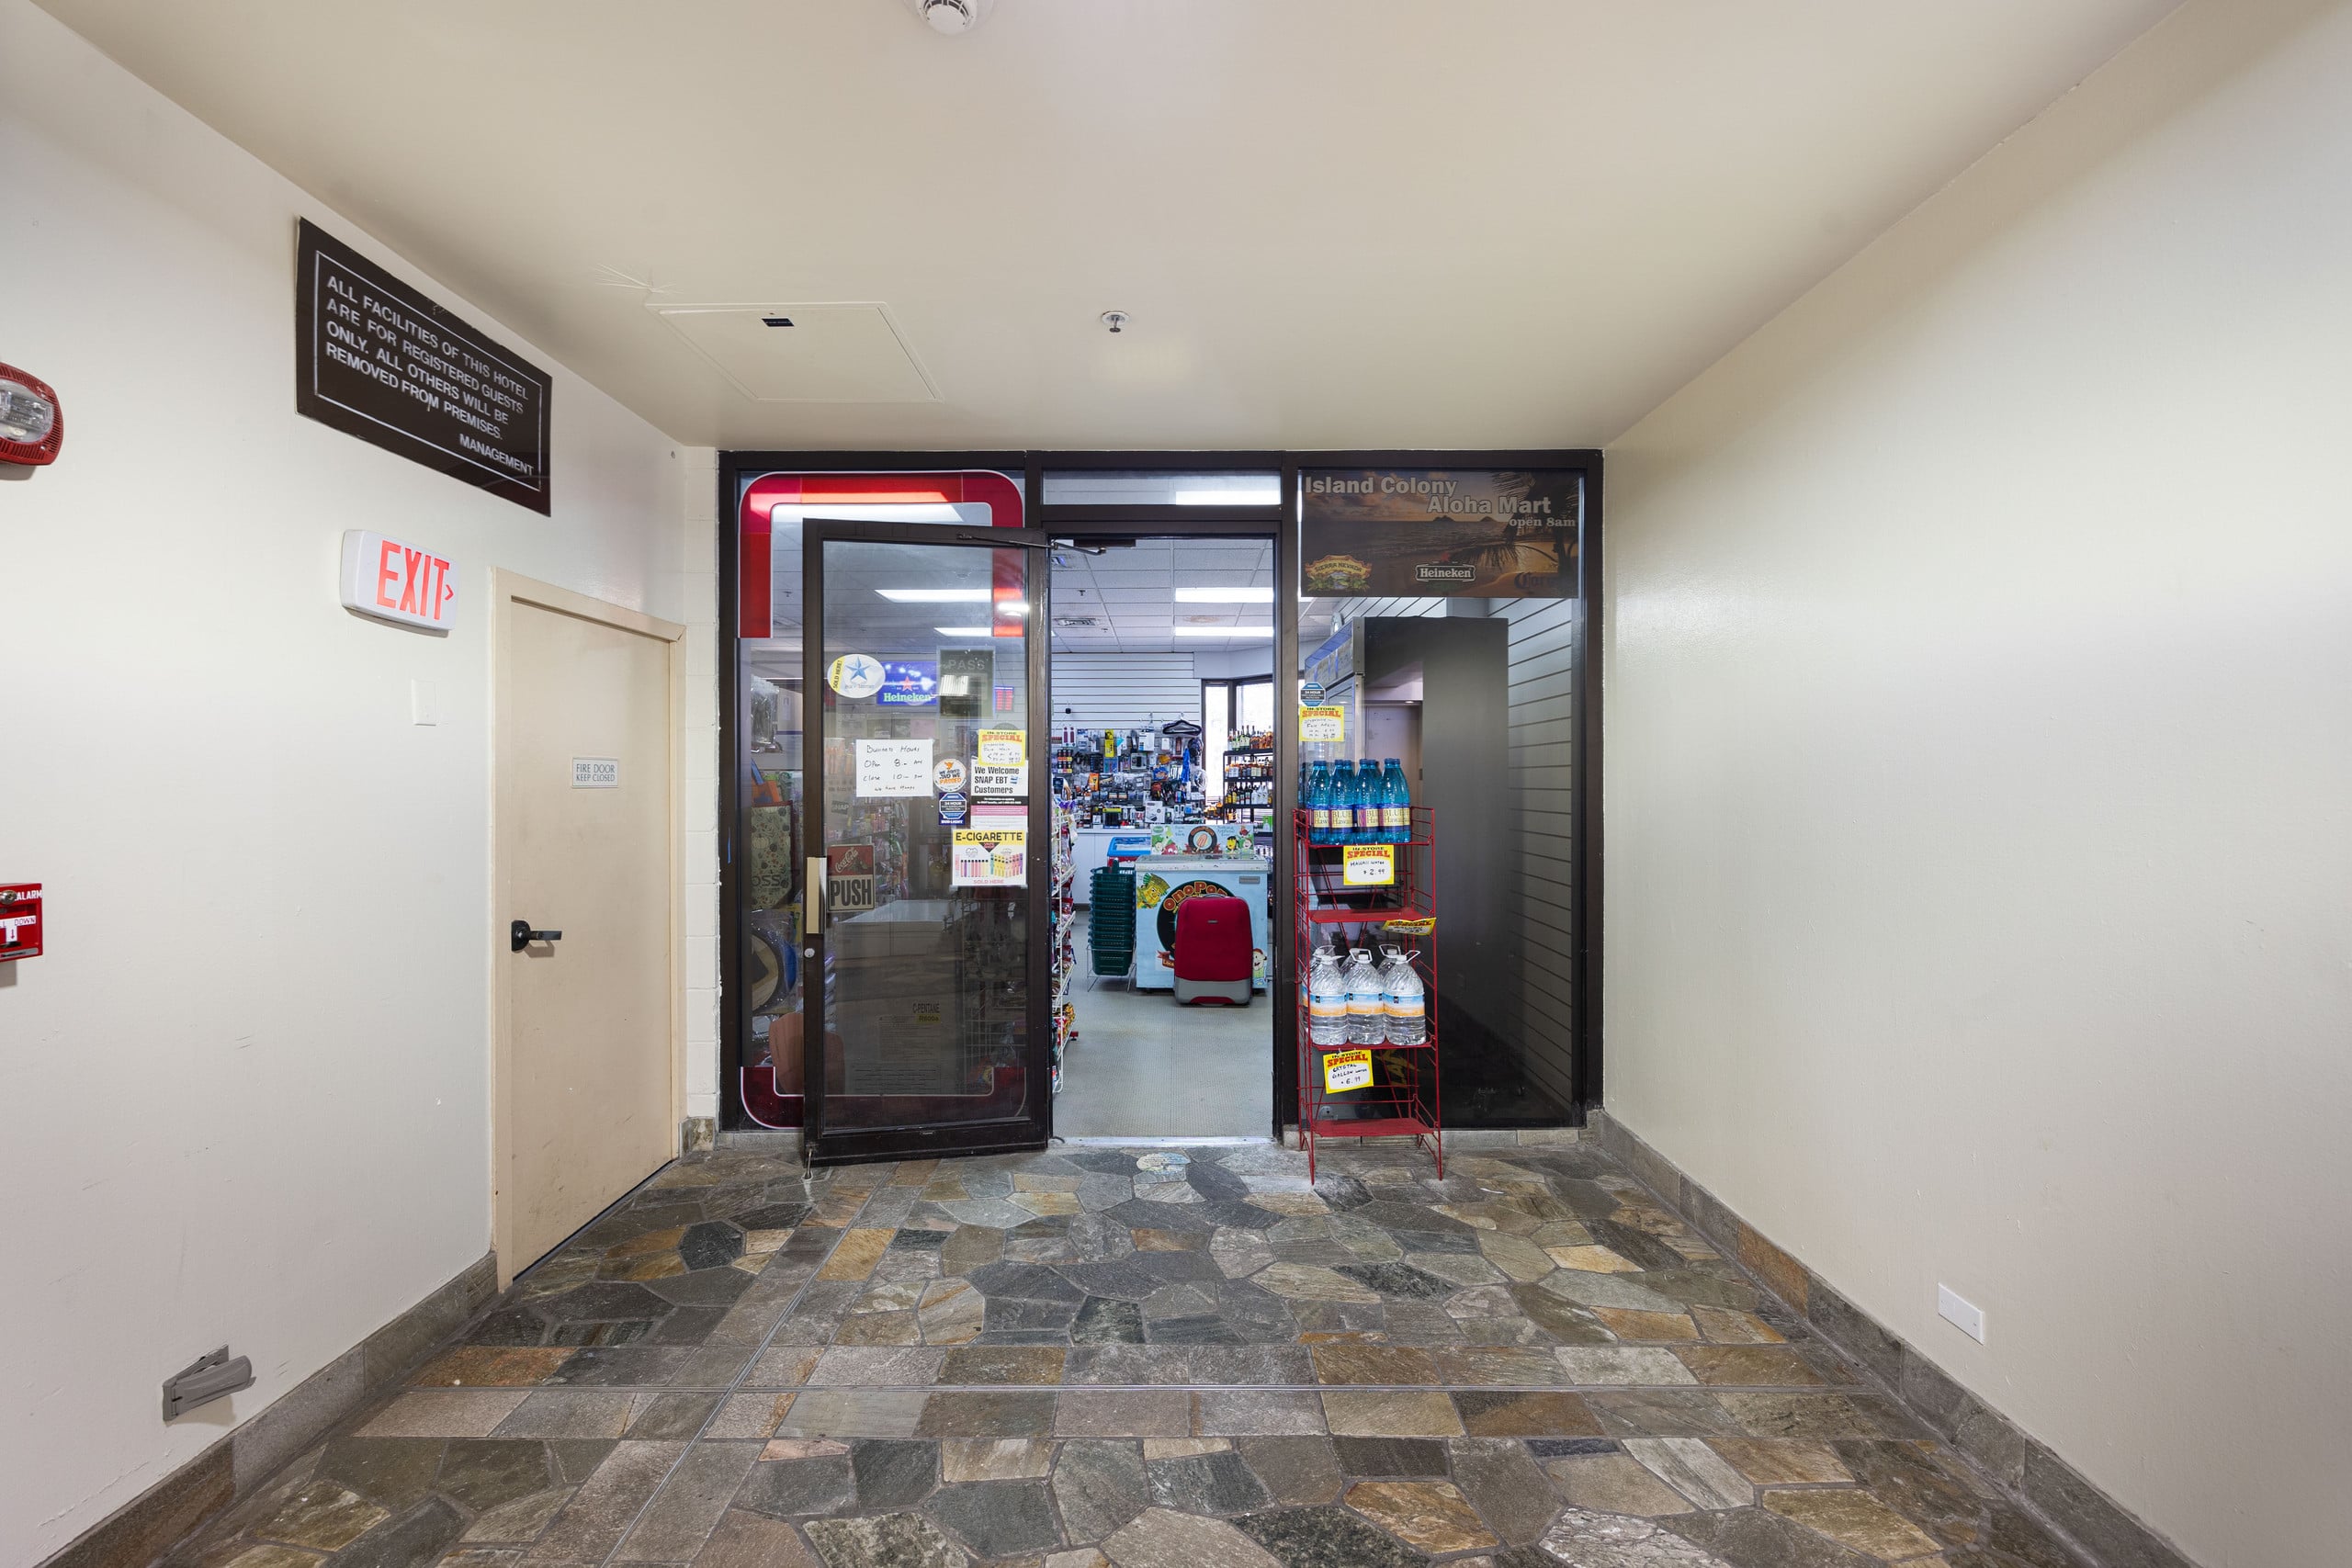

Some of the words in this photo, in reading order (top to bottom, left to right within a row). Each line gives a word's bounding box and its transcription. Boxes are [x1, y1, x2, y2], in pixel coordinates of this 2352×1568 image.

[327, 276, 357, 303] ALL
[364, 295, 437, 348] FACILITIES
[443, 342, 458, 358] OF
[463, 354, 490, 378] THIS
[493, 370, 528, 400] HOTEL
[327, 299, 360, 326] ARE
[368, 320, 396, 346] FOR
[403, 340, 479, 390] REGISTERED
[481, 383, 523, 413] GUESTS
[327, 321, 368, 354] ONLY.
[377, 348, 402, 370] ALL
[408, 364, 459, 400] OTHERS
[463, 391, 491, 416] WILL
[495, 412, 508, 425] BE
[327, 343, 398, 389] REMOVED
[401, 379, 438, 409] FROM
[444, 400, 503, 440] PREMISES.
[459, 434, 534, 476] MANAGEMENT
[1305, 476, 1374, 494] Island
[1380, 476, 1457, 496] Colony
[1427, 495, 1492, 513] Aloha
[1498, 496, 1552, 514] Mart
[1510, 518, 1542, 527] open
[1546, 516, 1576, 526] 8am
[1314, 562, 1338, 571] SIERRA
[1338, 562, 1363, 571] NEVADA
[1419, 568, 1472, 578] Heineken
[377, 540, 449, 620] EXIT
[949, 660, 985, 671] PASS
[884, 693, 932, 702] Heineken
[577, 764, 591, 773] FIRE
[594, 764, 616, 773] DOOR
[956, 832, 1022, 840] E-CIGARETTE
[1347, 851, 1390, 859] SPECIAL
[15, 889, 42, 900] ALARM
[831, 879, 871, 906] PUSH
[1163, 882, 1227, 910] OnoPo
[15, 918, 36, 926] DOWN
[1328, 1055, 1367, 1067] SPECIAL
[1332, 1064, 1357, 1072] CRYSTAL
